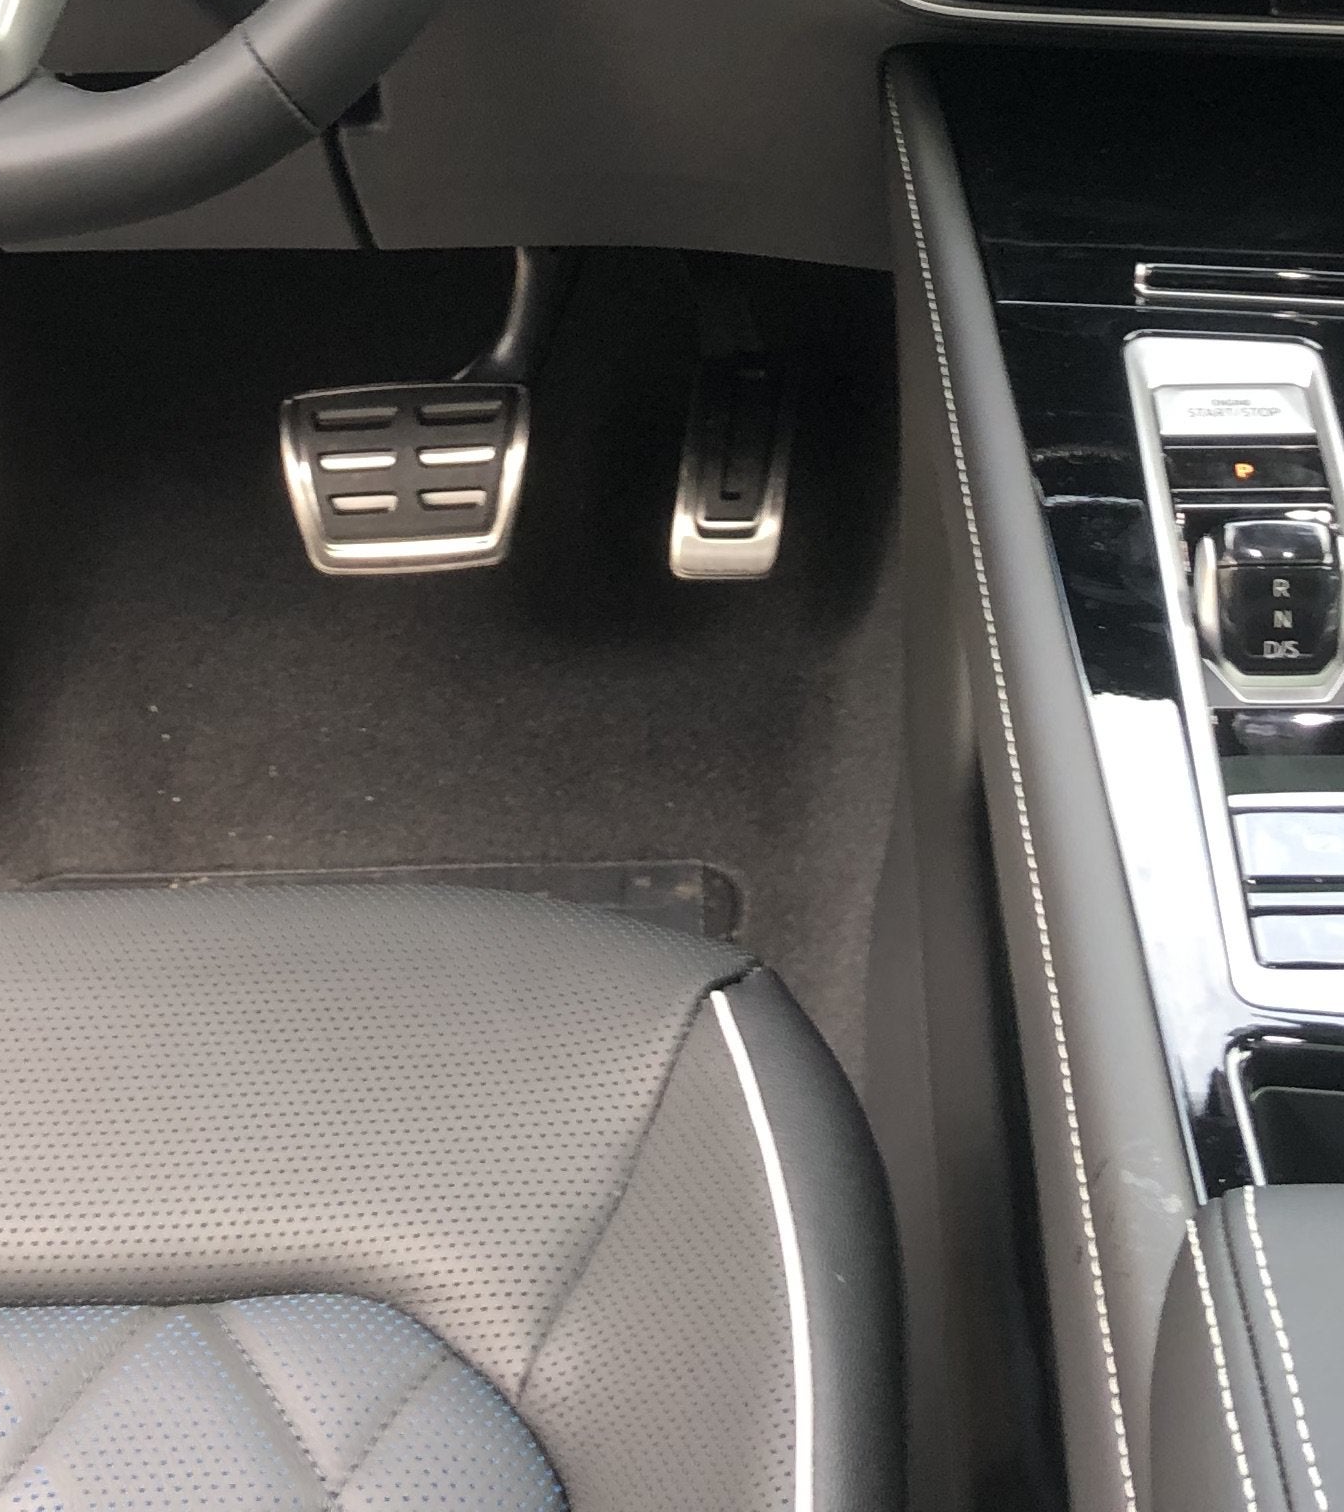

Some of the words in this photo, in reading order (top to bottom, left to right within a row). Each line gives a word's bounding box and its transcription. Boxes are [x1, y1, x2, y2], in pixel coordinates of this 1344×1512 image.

[1234, 462, 1255, 479] P
[1272, 578, 1291, 598] R
[1273, 609, 1293, 629] N
[1262, 639, 1301, 659] D/S
